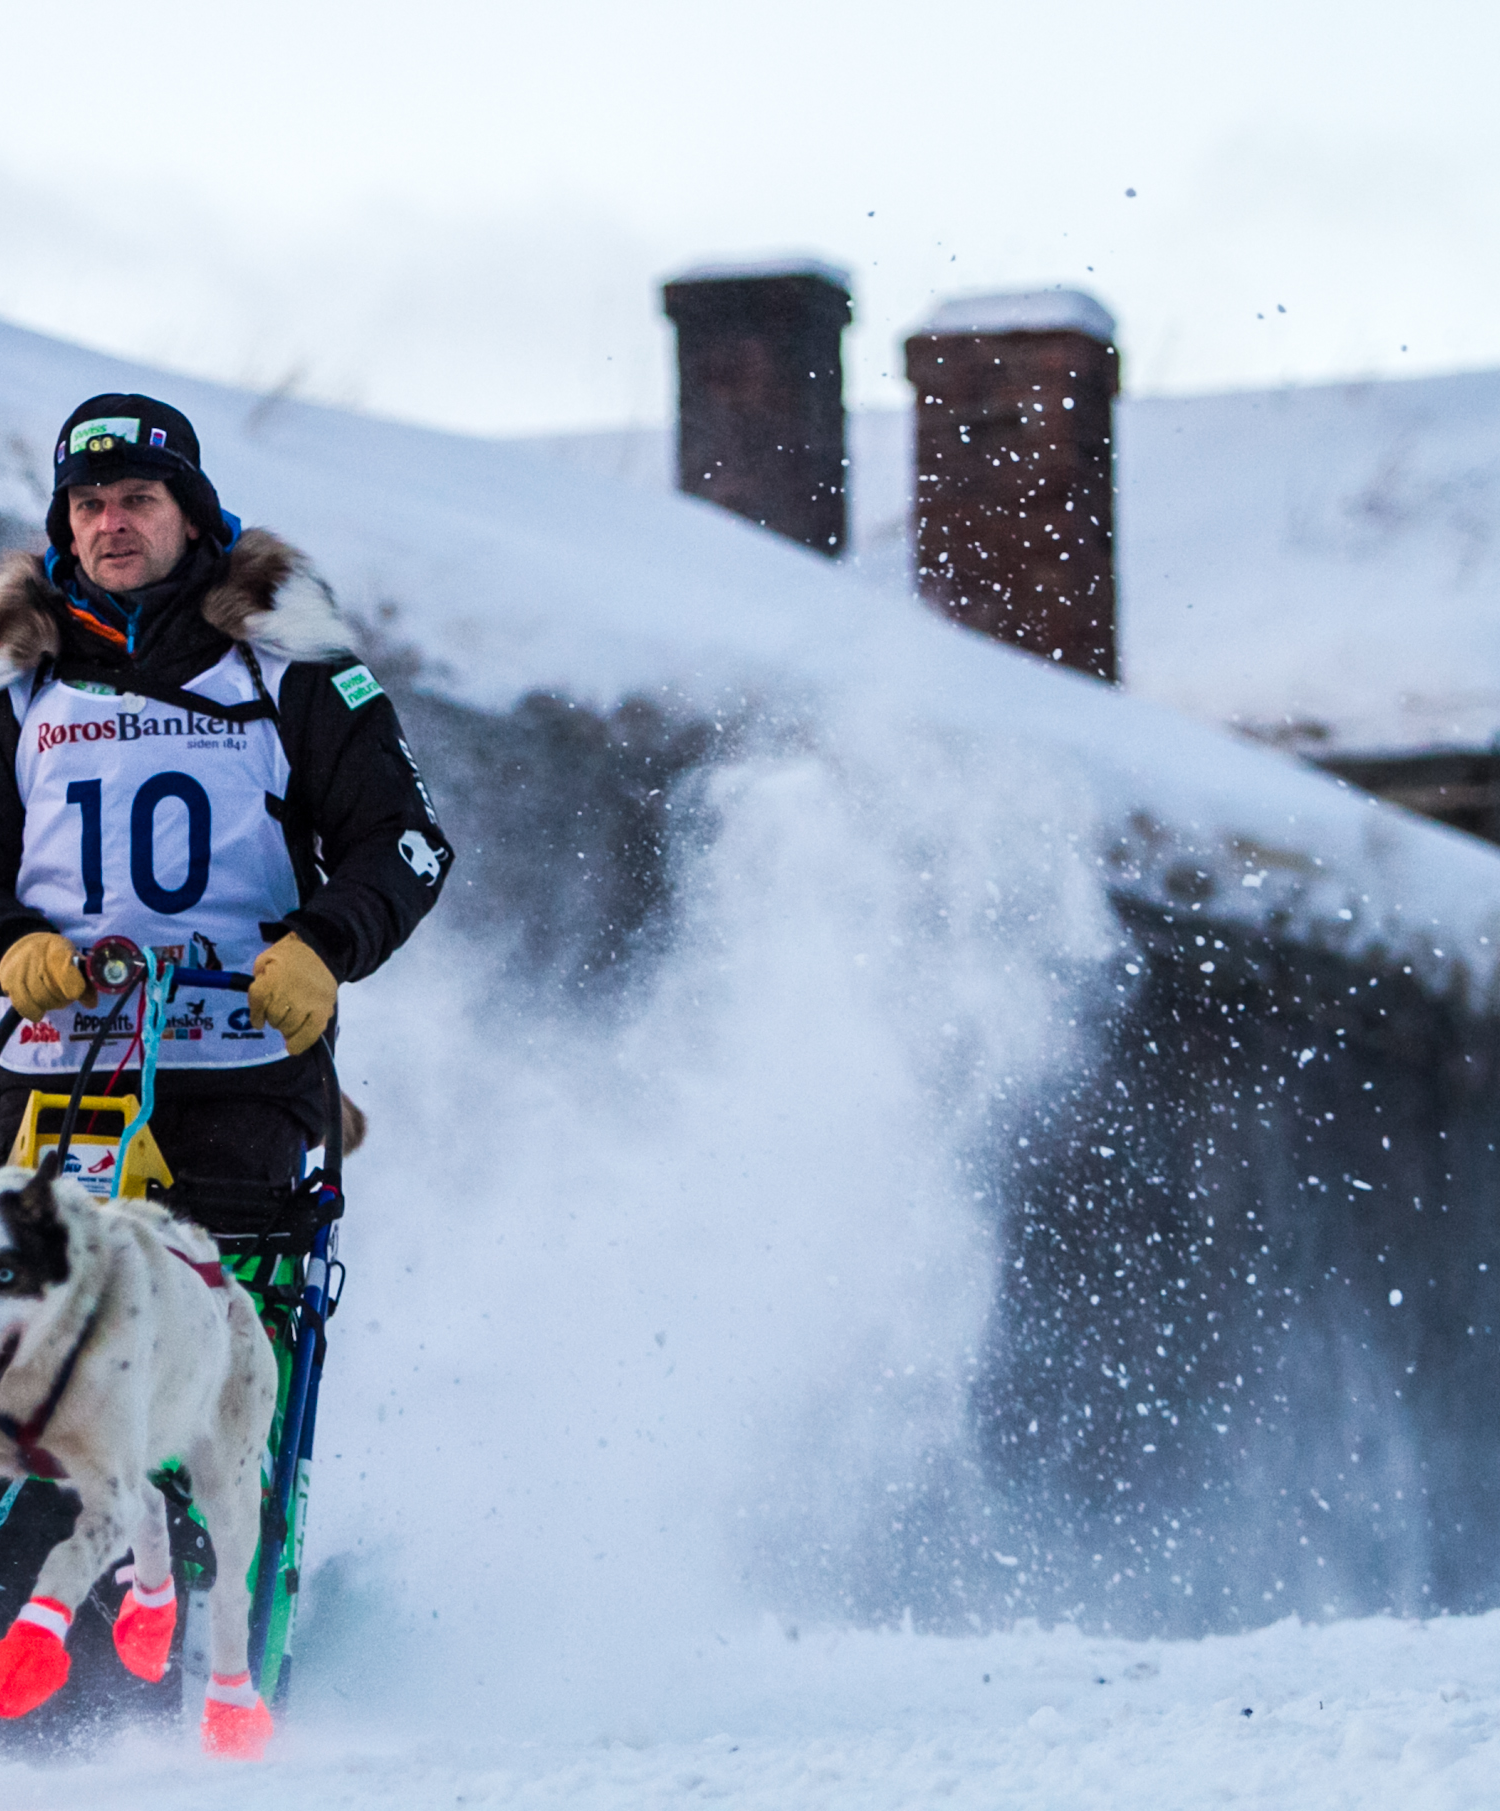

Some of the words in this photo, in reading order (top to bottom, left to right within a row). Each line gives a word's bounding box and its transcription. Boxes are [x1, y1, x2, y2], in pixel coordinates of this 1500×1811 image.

[38, 711, 246, 753] RørosBanken
[187, 738, 219, 749] siden
[222, 738, 247, 751] 1842
[66, 771, 212, 915] 10
[165, 1013, 214, 1030] atskog
